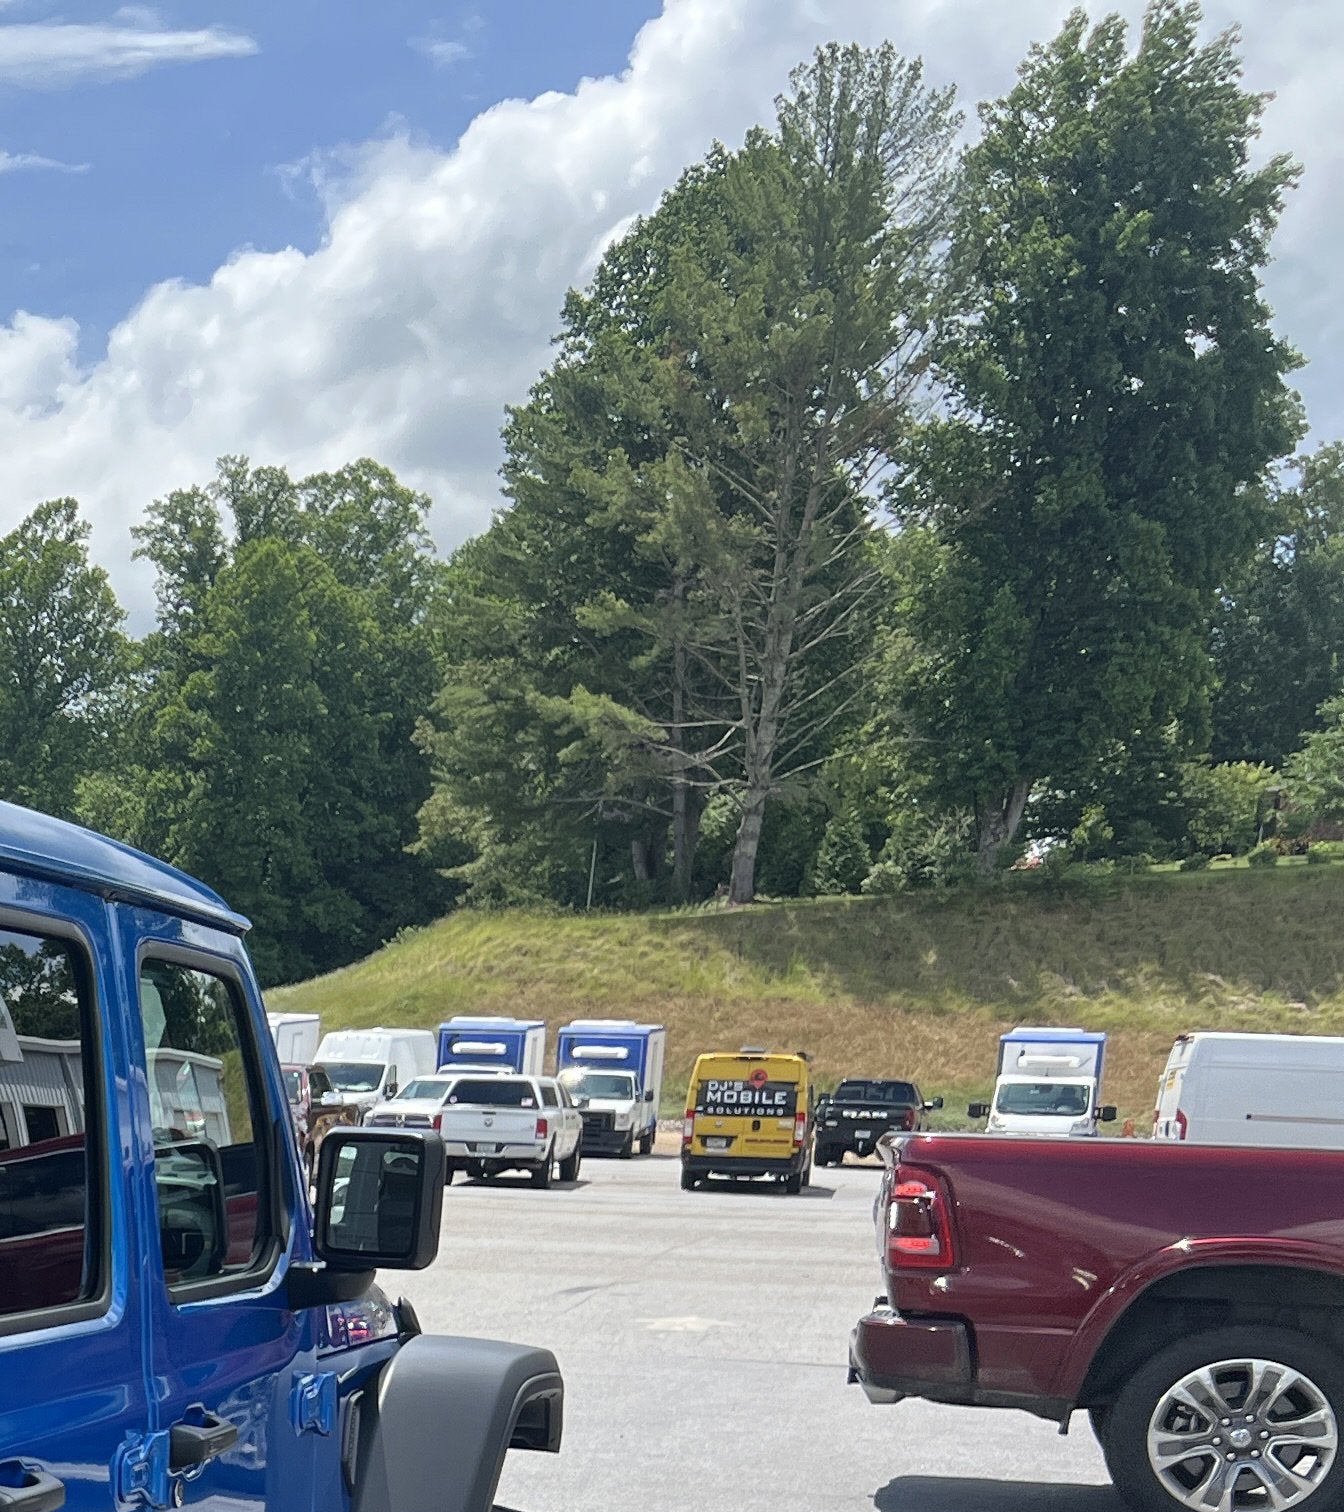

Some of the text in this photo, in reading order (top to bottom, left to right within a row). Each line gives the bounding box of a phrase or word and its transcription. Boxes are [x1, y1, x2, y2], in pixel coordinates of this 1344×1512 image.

[708, 1080, 744, 1091] DJ'S
[706, 1090, 787, 1105] MOBILE
[707, 1106, 784, 1116] SOLUTIONS
[842, 1110, 888, 1119] RAM
